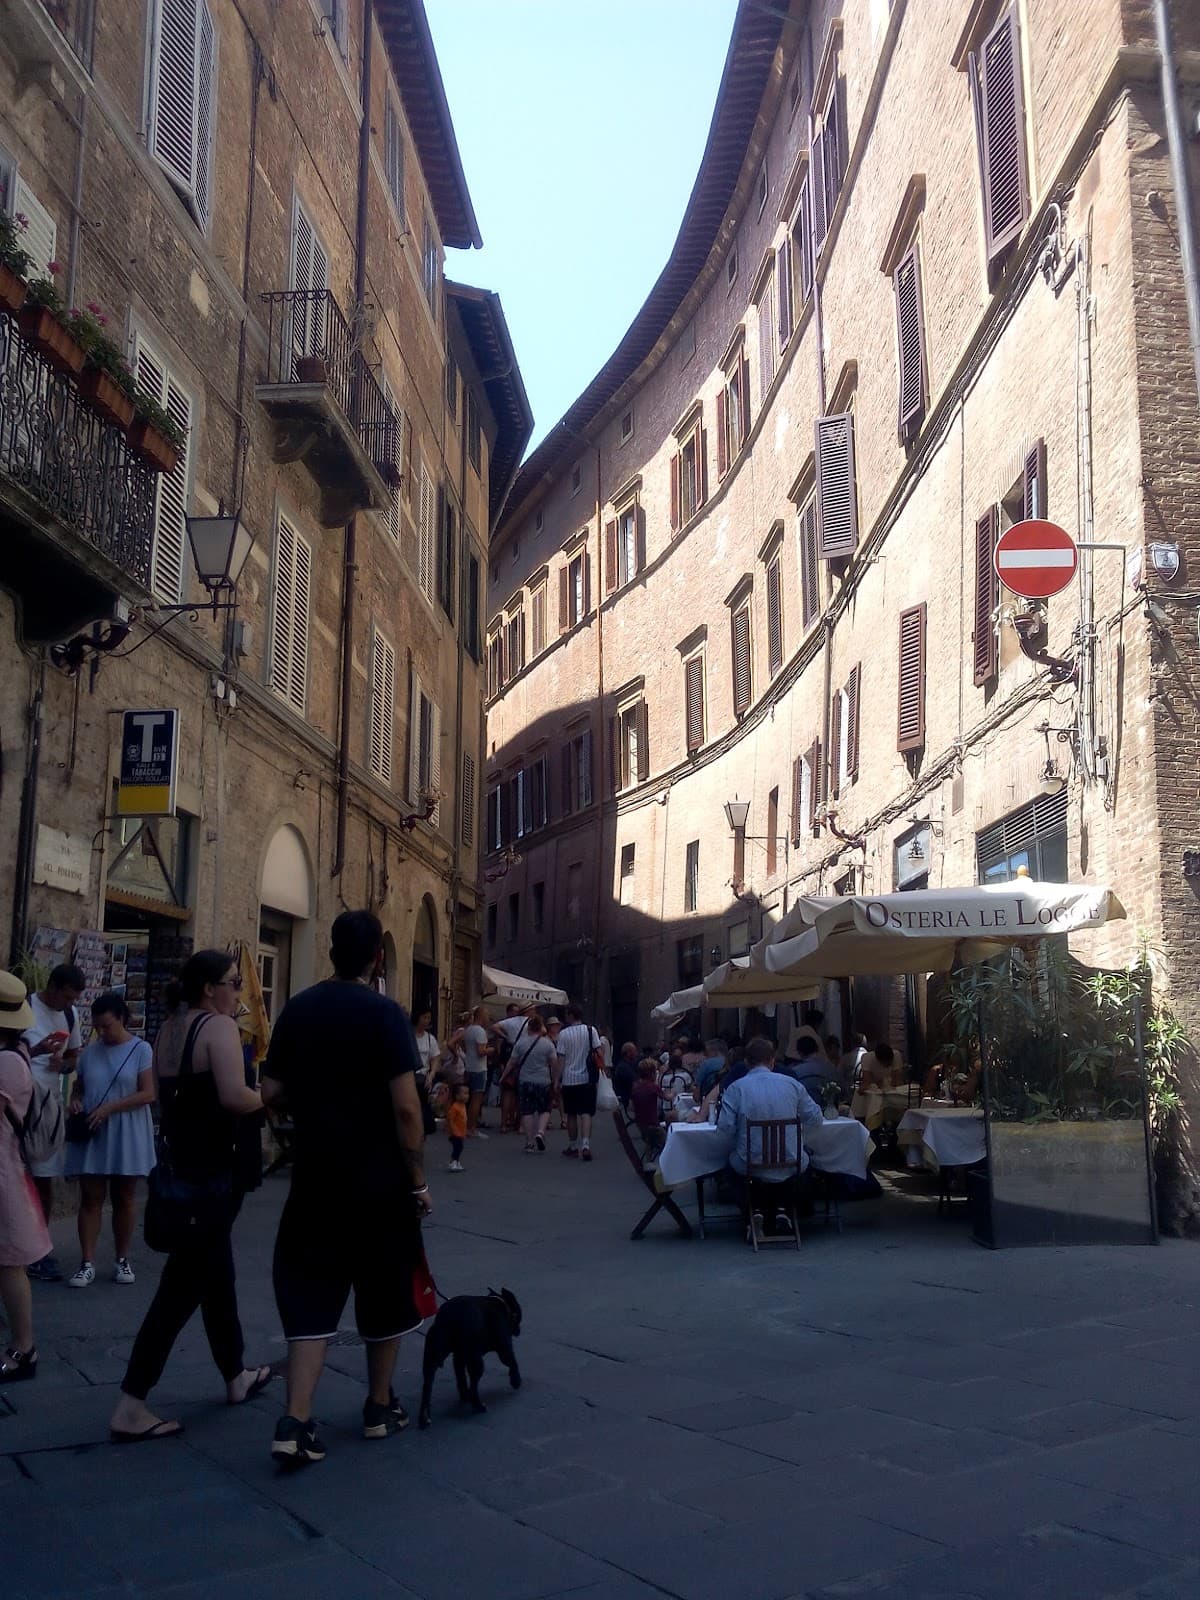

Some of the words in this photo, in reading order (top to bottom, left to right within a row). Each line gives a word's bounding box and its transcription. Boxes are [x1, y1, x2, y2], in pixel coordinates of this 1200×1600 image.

[132, 713, 166, 763] T
[865, 901, 971, 929] OSTERIA
[979, 909, 1008, 927] LE
